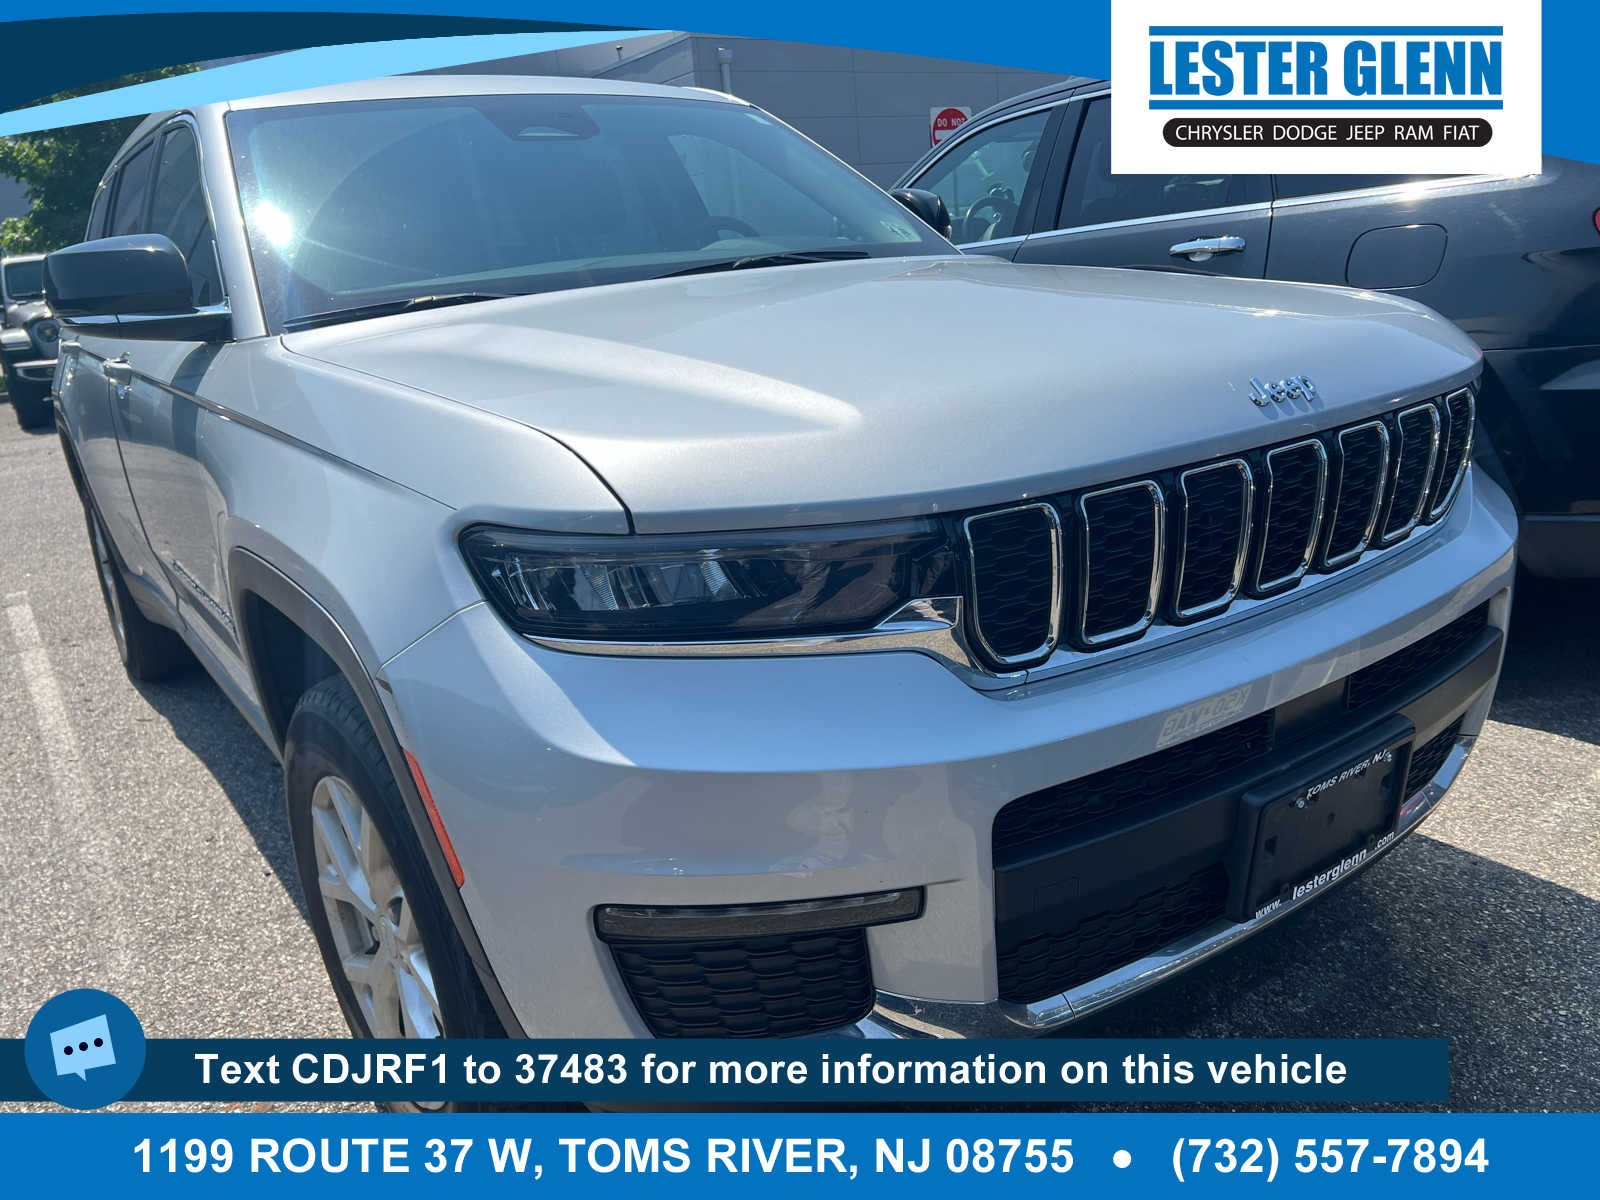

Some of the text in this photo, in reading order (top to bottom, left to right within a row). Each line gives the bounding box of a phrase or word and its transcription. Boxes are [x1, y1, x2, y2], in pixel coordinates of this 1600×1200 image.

[937, 118, 948, 128] DO
[1248, 375, 1316, 407] Jeep
[1306, 776, 1337, 798] TOMS
[1373, 750, 1387, 763] NJ
[1292, 849, 1367, 901] lesterglenn
